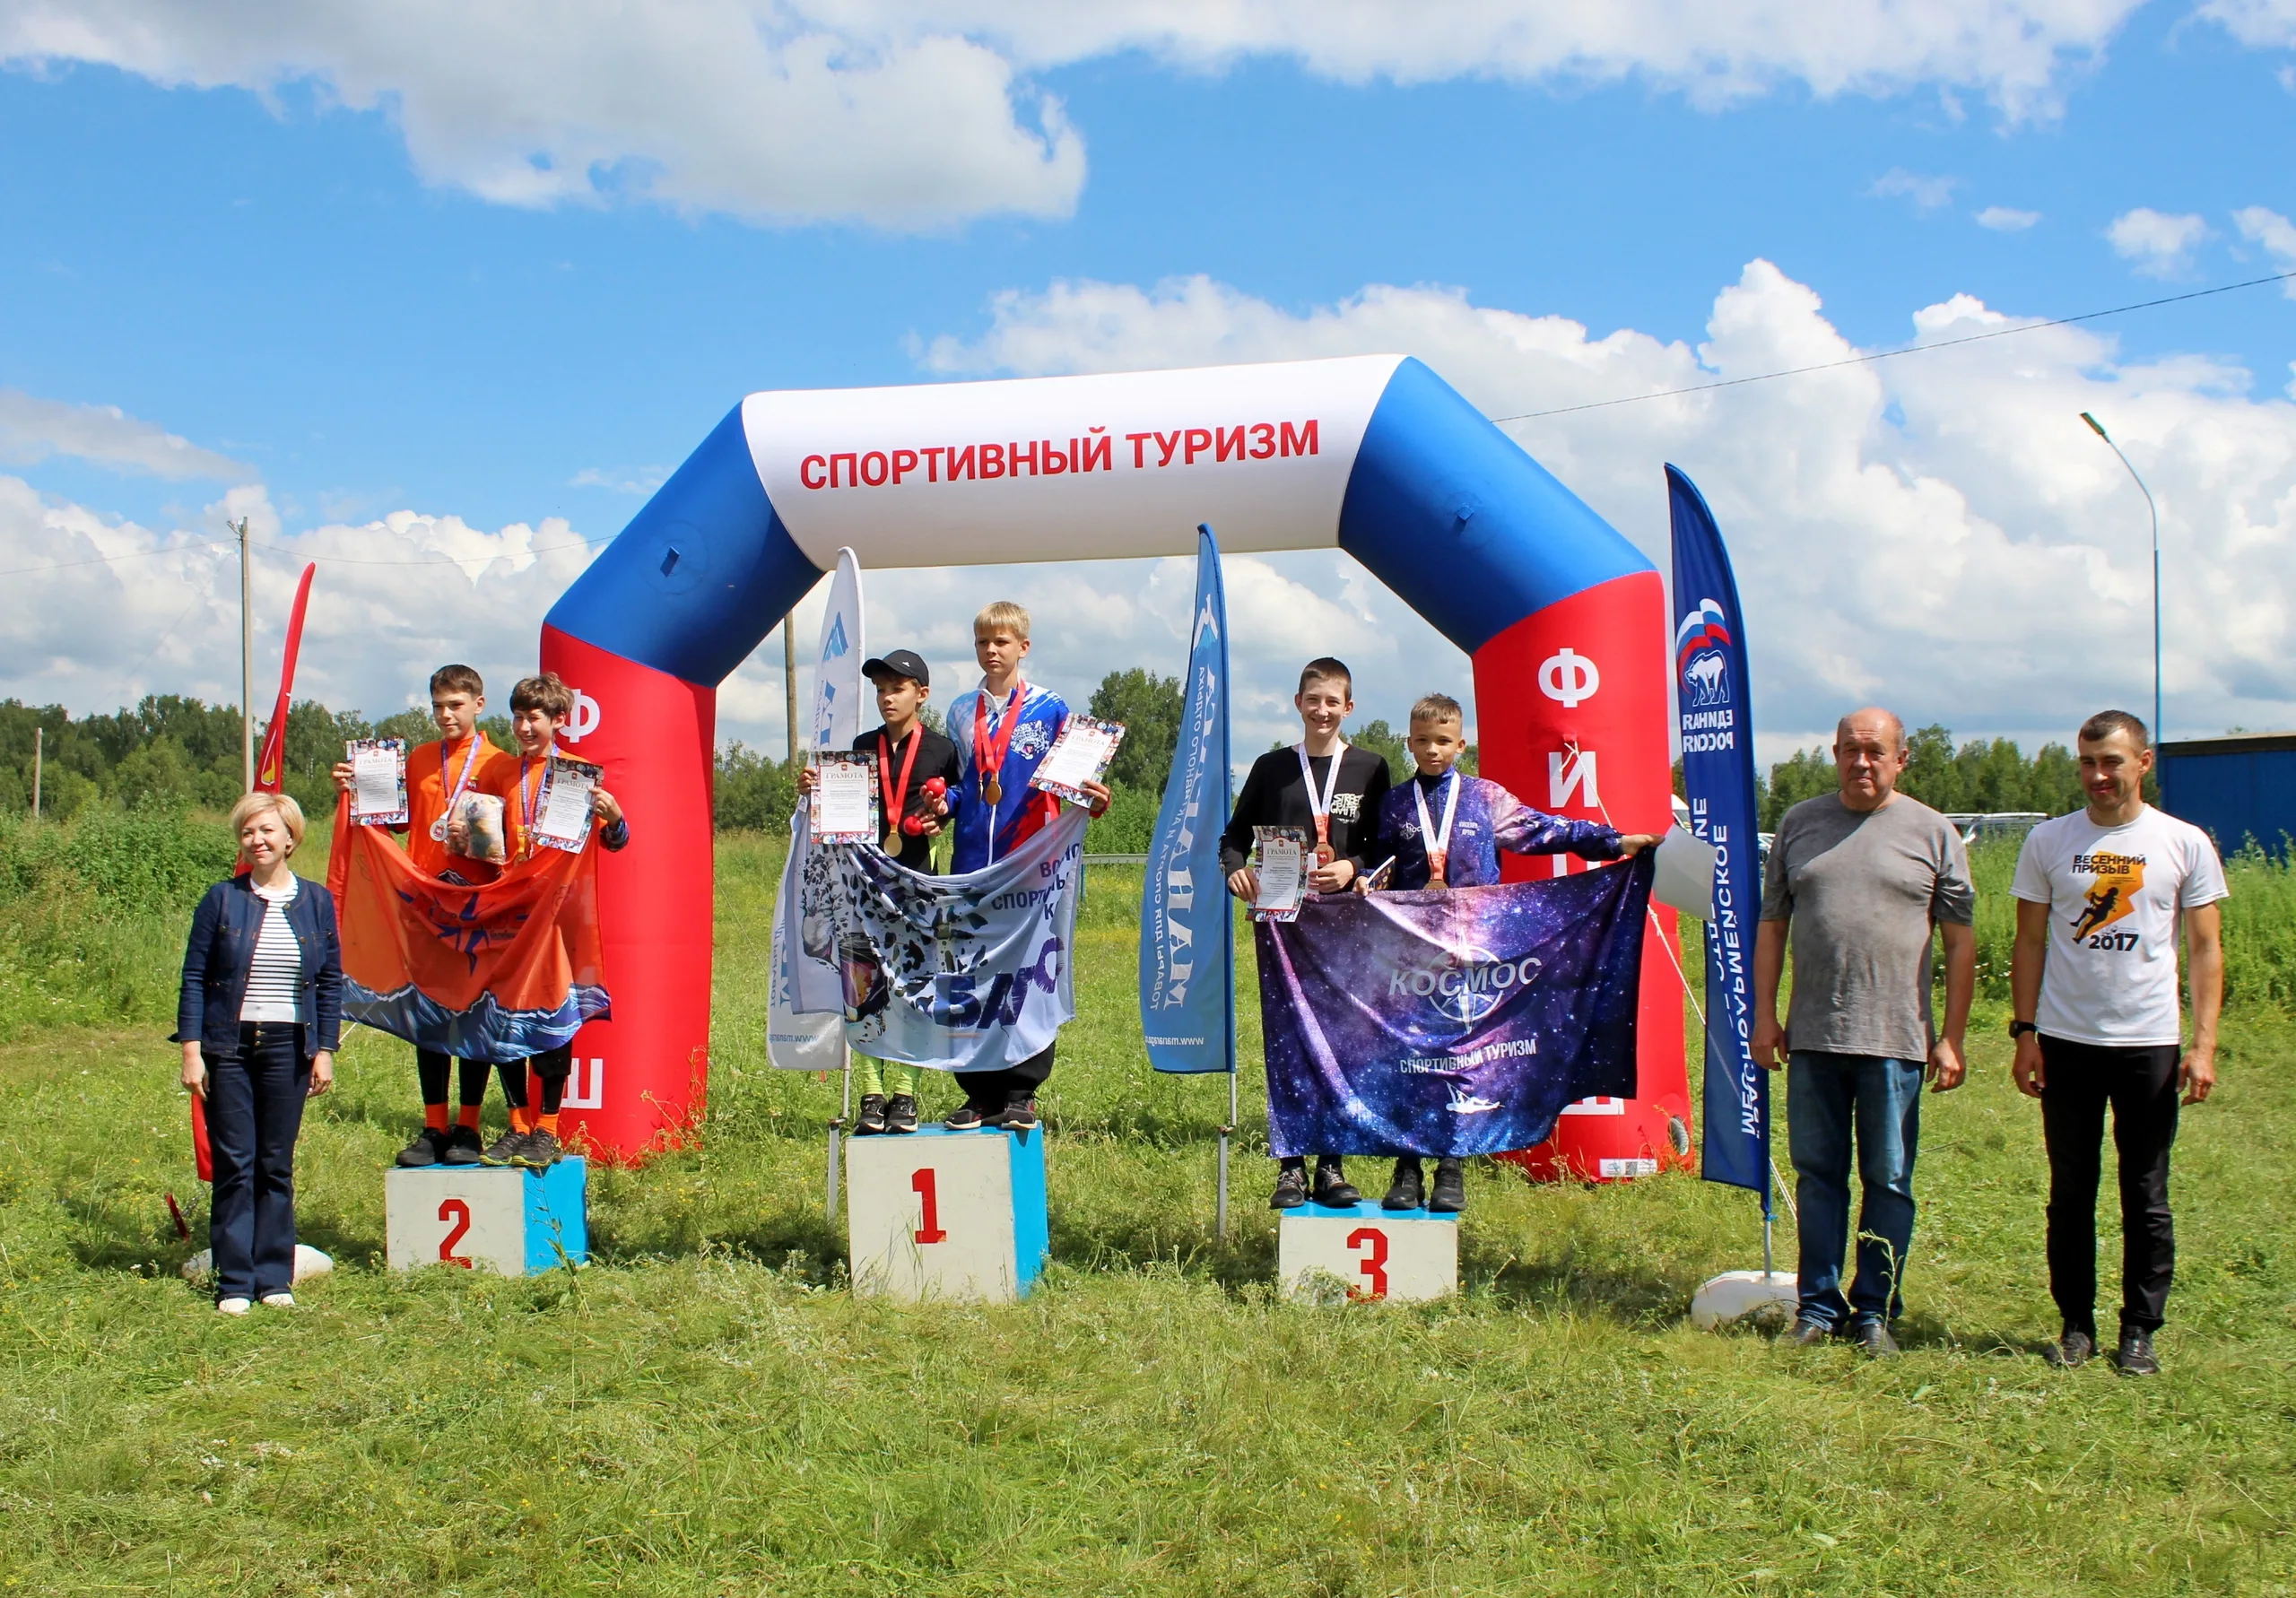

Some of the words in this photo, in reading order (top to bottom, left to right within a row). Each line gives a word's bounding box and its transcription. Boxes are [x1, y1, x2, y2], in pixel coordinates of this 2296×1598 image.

[800, 426, 1113, 490] СПОРТИВНЫЙ
[1125, 419, 1320, 469] ТУРИЗМ
[2072, 864, 2130, 874] ПРИЗЫВ
[2073, 854, 2147, 866] ВЕСЕННИЙ
[2088, 933, 2139, 951] 2017
[1388, 957, 1543, 997] КОСМОС
[1484, 1038, 1537, 1061] ТУРИЗМ
[911, 1168, 947, 1244] 1
[438, 1199, 473, 1270] 2
[1346, 1228, 1388, 1303] 3
